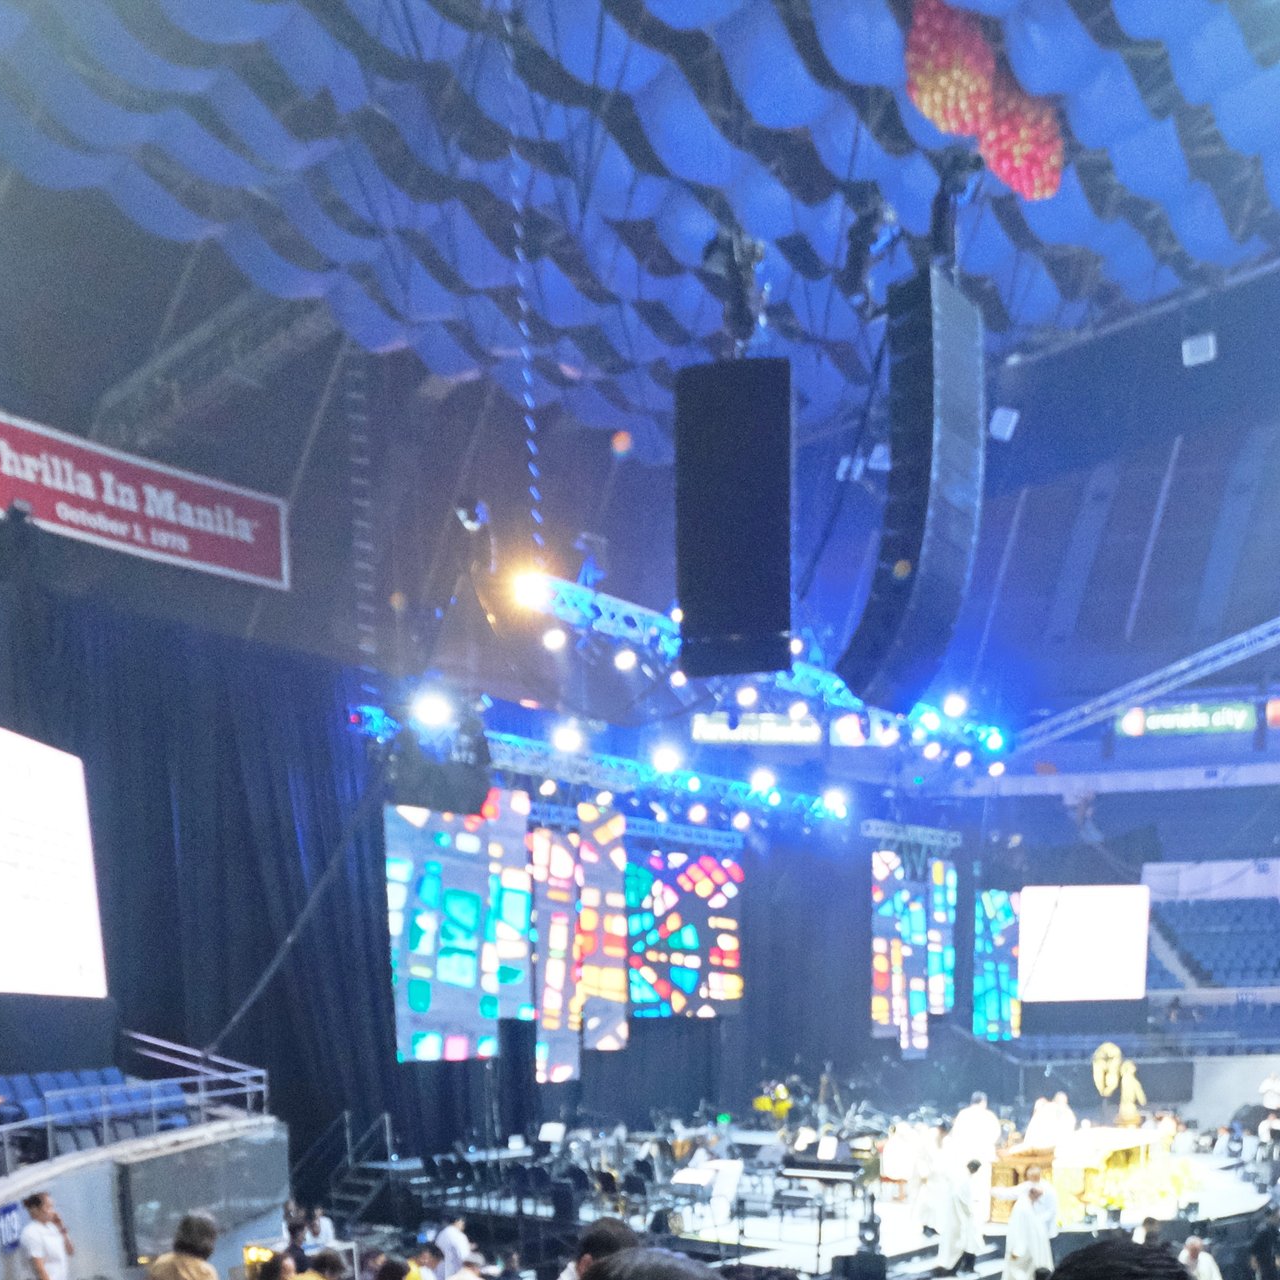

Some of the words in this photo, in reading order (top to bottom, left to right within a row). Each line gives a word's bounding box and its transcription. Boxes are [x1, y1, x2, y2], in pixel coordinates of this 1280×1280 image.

[100, 470, 141, 513] In
[55, 501, 130, 537] October
[1211, 706, 1248, 730] city
